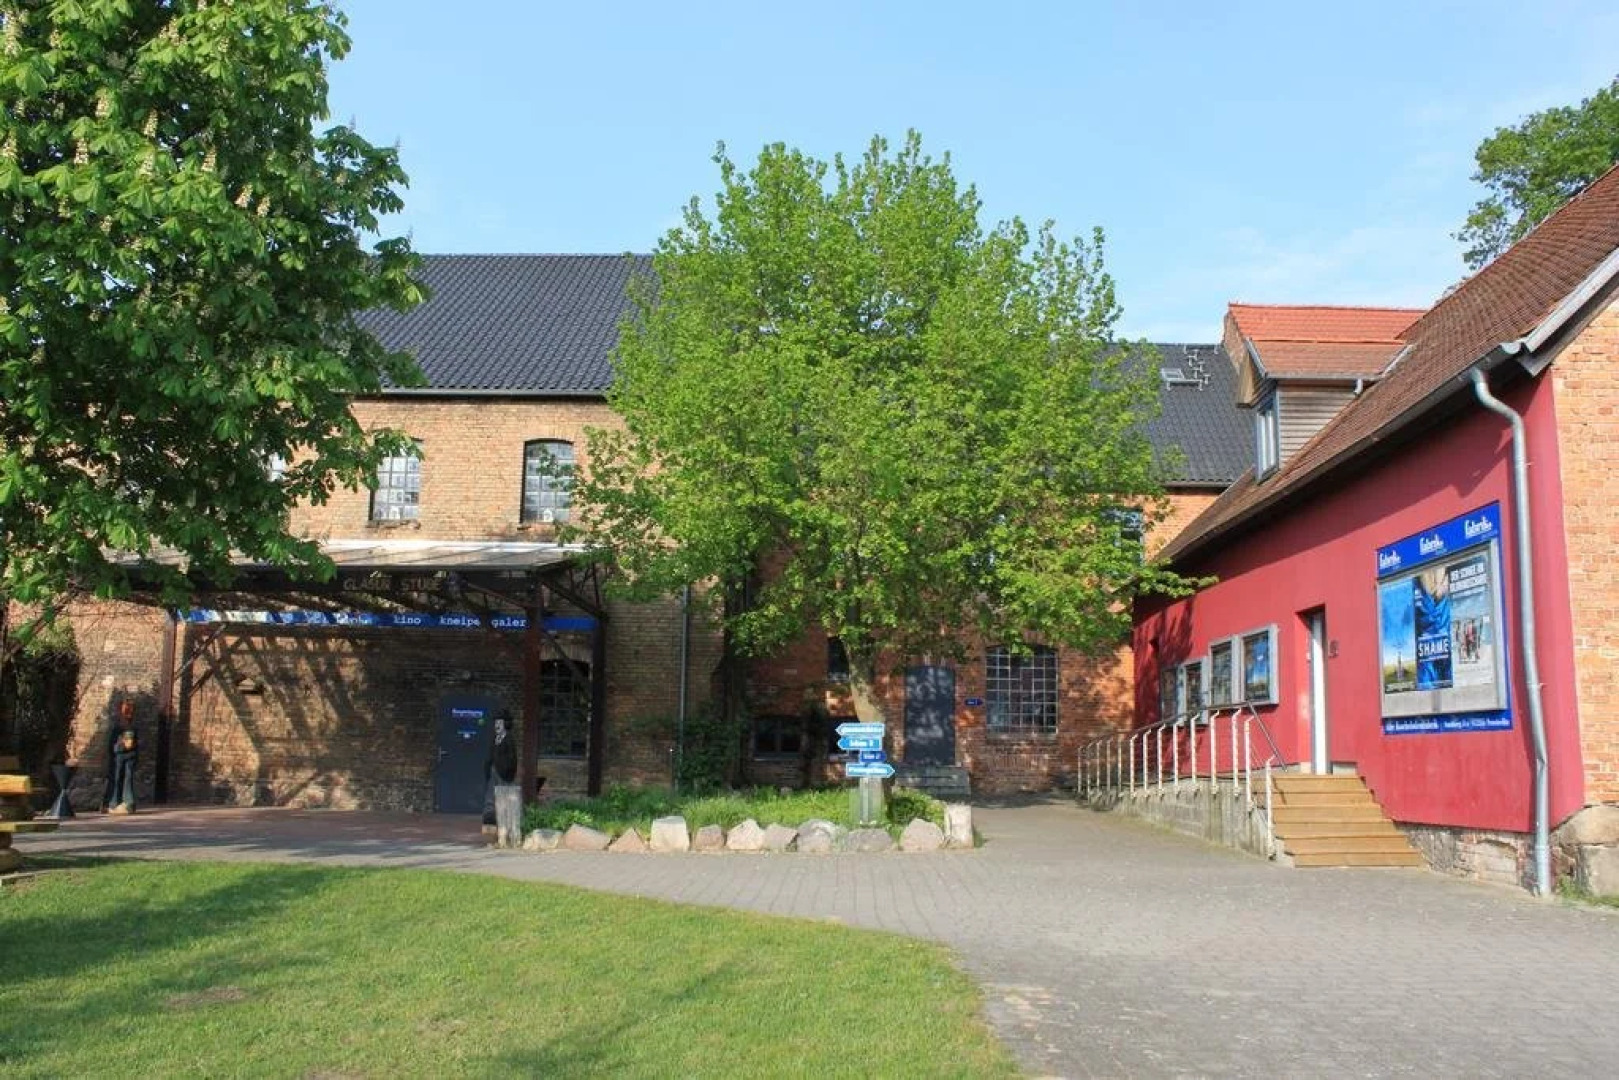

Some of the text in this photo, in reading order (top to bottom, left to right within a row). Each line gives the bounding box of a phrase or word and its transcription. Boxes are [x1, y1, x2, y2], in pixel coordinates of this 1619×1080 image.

[393, 614, 421, 625] kino
[440, 615, 481, 627] kneipe
[1418, 639, 1449, 657] SHAME
